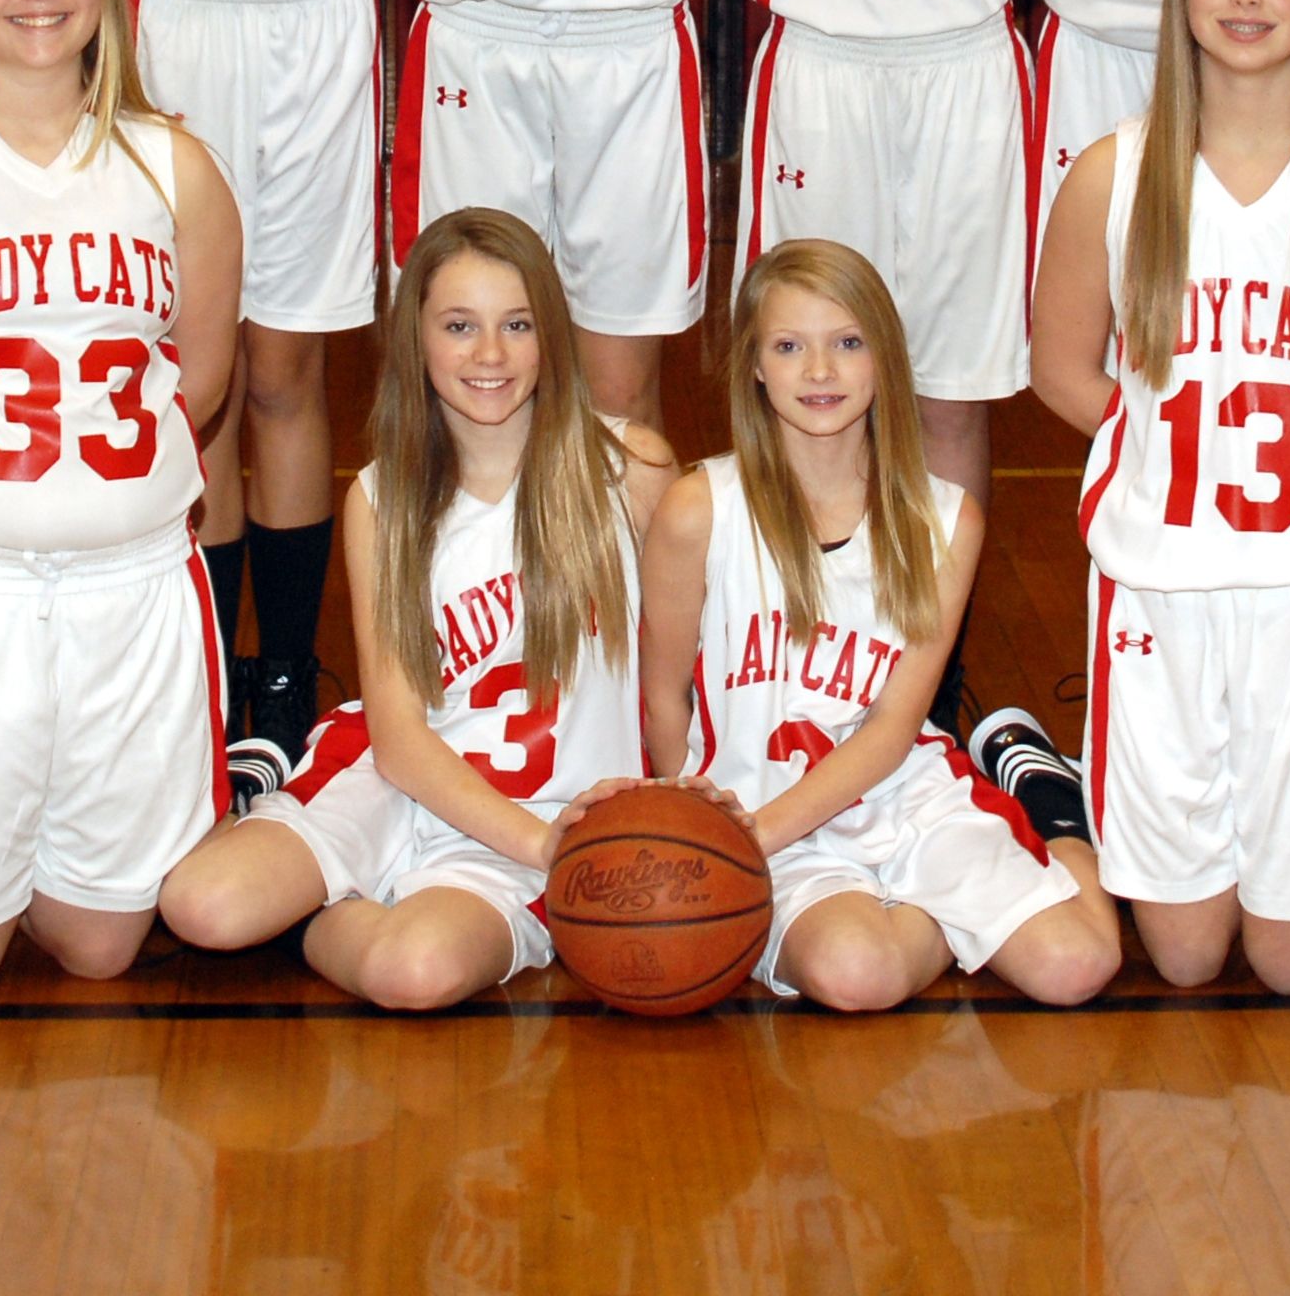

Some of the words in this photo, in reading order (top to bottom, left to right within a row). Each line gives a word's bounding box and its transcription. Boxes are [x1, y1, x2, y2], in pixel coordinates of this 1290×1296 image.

[69, 232, 176, 321] CATS
[462, 661, 561, 799] 3
[565, 849, 710, 906] Rawlings
